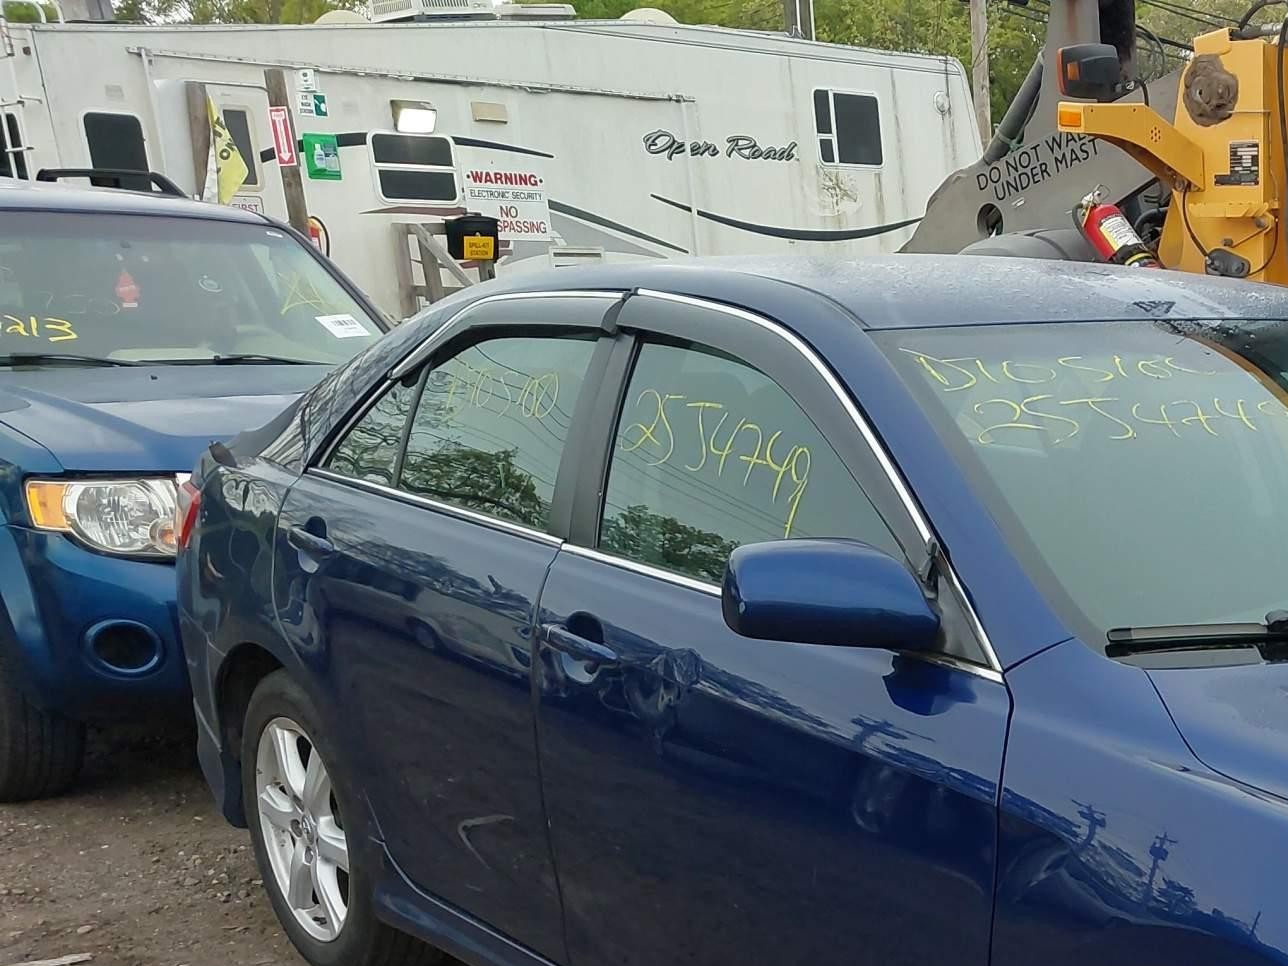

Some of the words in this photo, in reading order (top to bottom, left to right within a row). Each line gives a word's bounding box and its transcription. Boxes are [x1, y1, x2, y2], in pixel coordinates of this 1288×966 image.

[643, 129, 720, 161] Open
[726, 135, 798, 161] Road
[976, 166, 1002, 191] DO
[1005, 144, 1042, 177] NOT
[1045, 131, 1088, 155] WAL
[994, 162, 1051, 201] UNDER
[1053, 138, 1101, 173] MAST
[469, 170, 538, 187] WARNING
[470, 188, 510, 199] ELECTRONIC
[511, 191, 542, 201] SECURITY
[500, 205, 519, 218] NO
[497, 220, 547, 233] SPASSING
